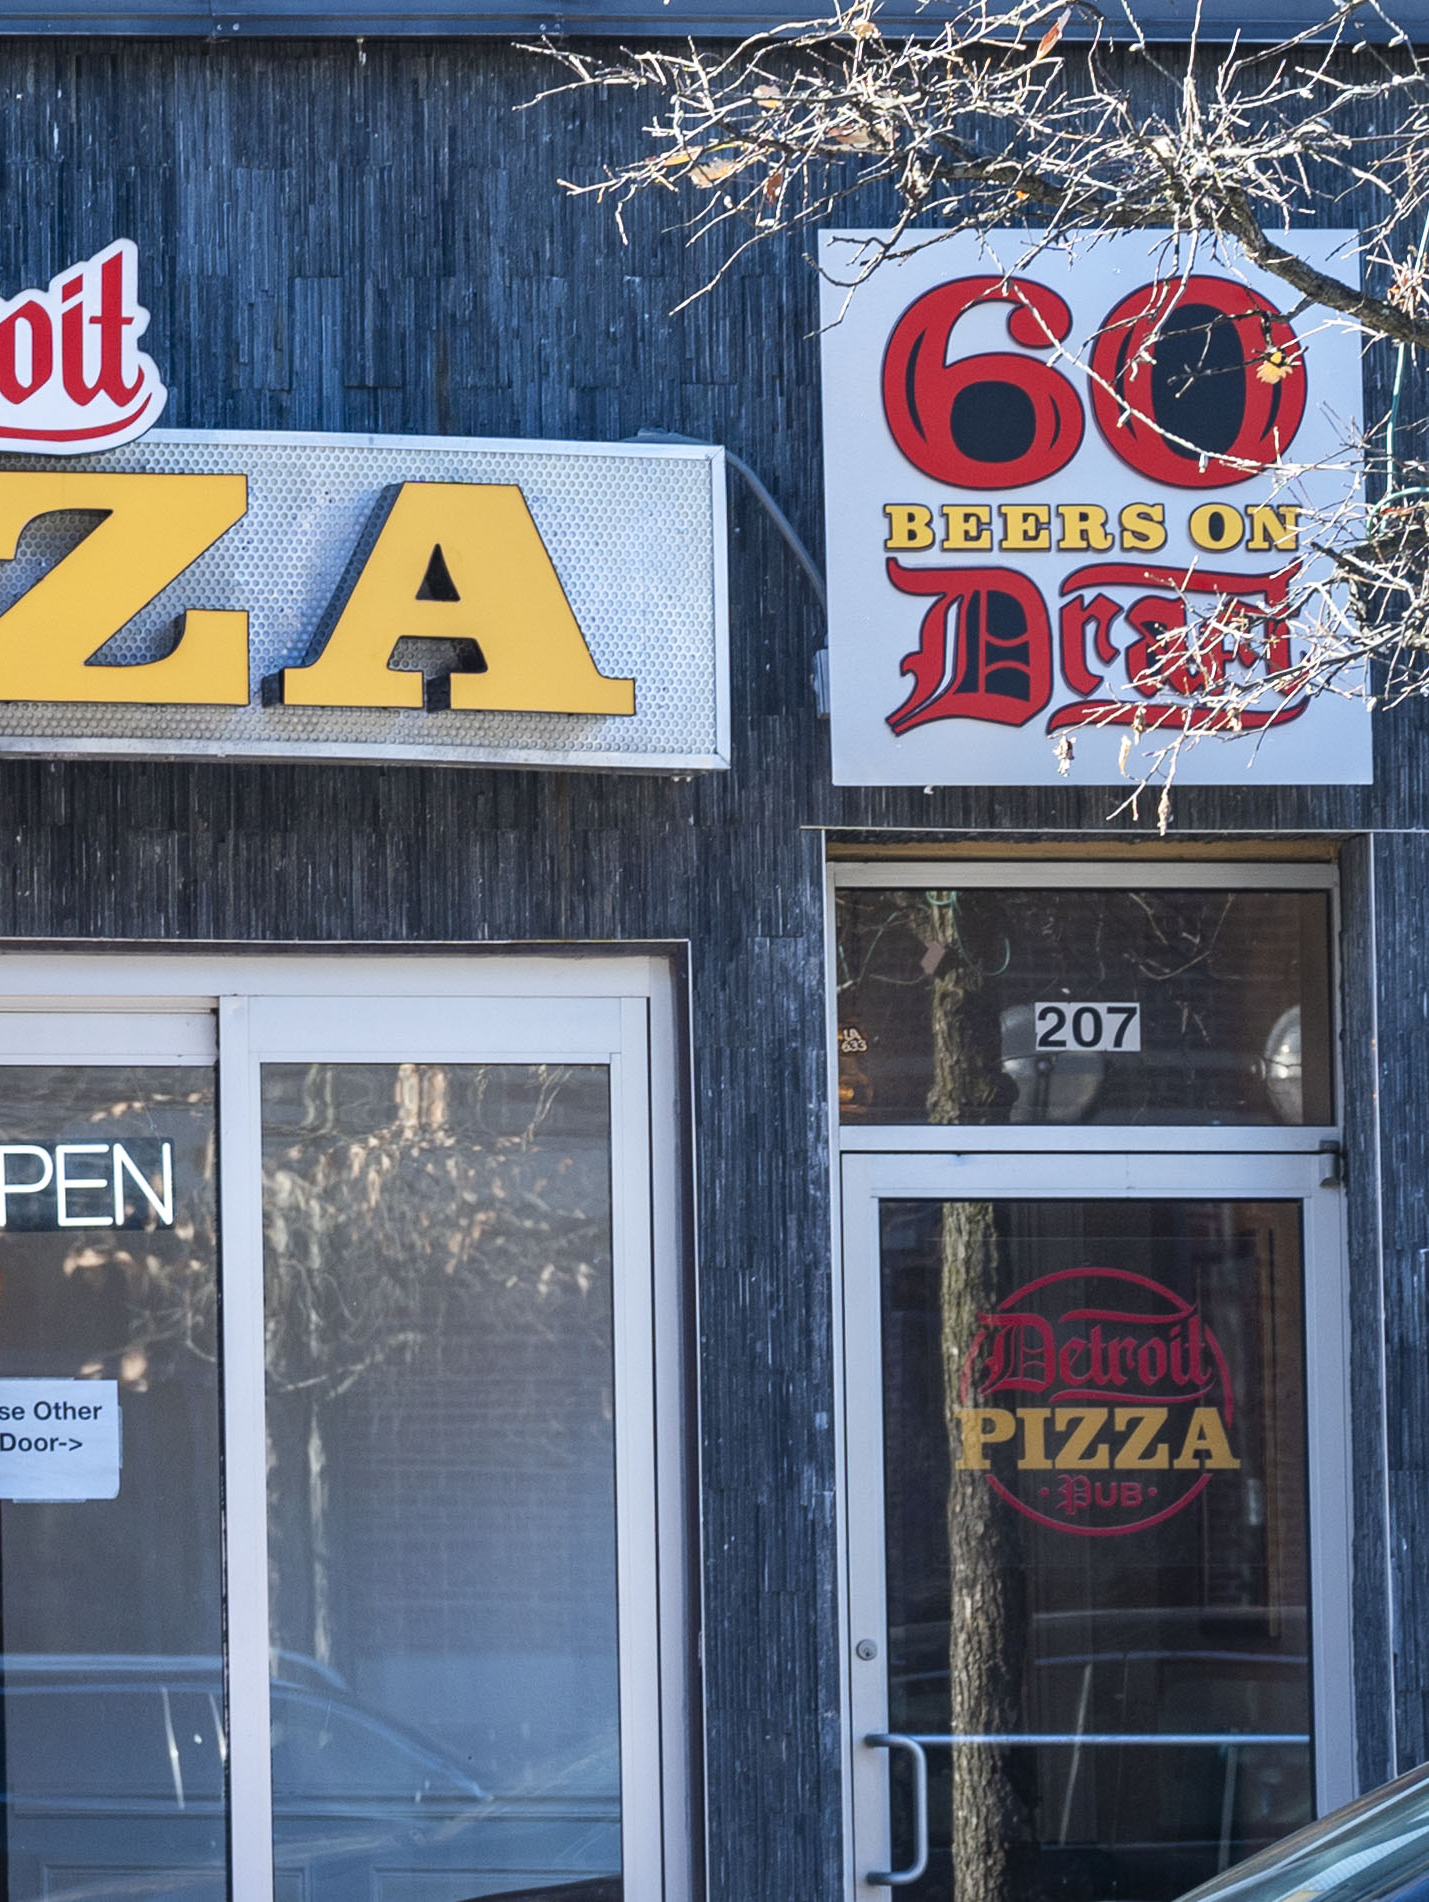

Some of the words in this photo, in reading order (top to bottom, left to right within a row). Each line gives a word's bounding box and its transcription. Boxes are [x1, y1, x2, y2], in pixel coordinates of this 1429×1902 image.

[882, 275, 1308, 491] 60
[883, 502, 1168, 553] BEERS
[1189, 502, 1300, 553] ON
[1036, 1006, 1139, 1049] 207
[979, 1304, 1217, 1404] Detroit
[33, 1401, 103, 1421] Other
[953, 1406, 1242, 1470] PIZZA
